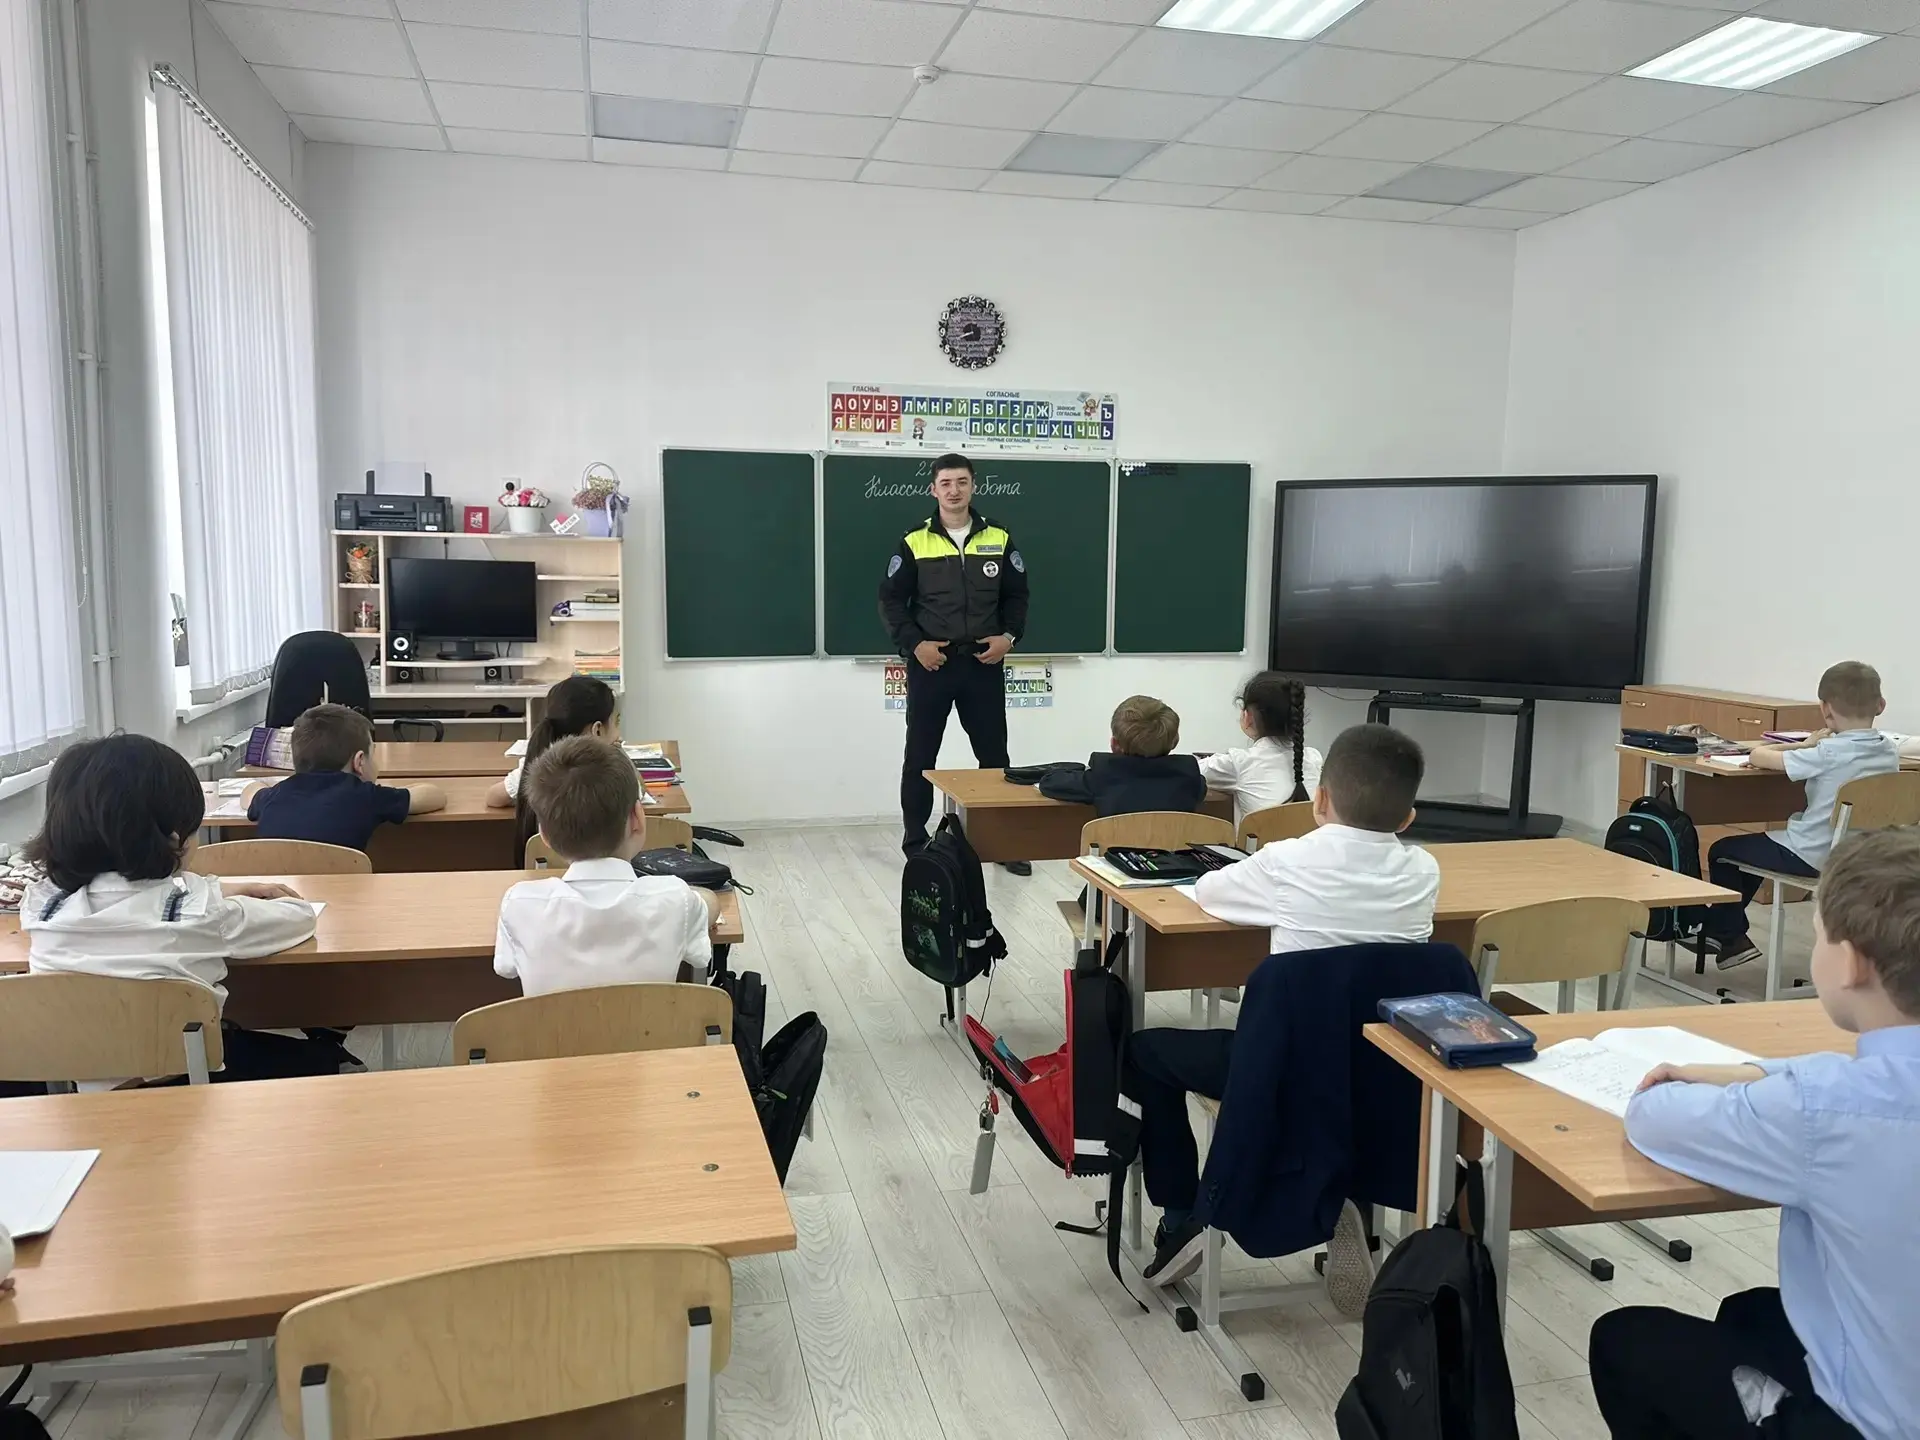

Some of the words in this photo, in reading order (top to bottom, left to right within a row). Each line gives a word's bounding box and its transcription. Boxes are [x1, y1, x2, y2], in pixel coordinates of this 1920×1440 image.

[834, 398, 843, 410] А
[848, 398, 857, 410] О
[862, 399, 870, 410] У
[875, 400, 886, 411] Ы
[890, 400, 898, 412] Э
[904, 400, 912, 412] Л
[917, 401, 926, 412] М
[931, 402, 940, 413] Н
[945, 402, 952, 414] Р
[958, 400, 967, 414] Й
[972, 403, 980, 414] Б
[986, 404, 994, 415] В
[1000, 404, 1007, 415] Г
[1024, 405, 1034, 418] Д
[1037, 405, 1049, 417] Ж
[1102, 408, 1112, 418] Ъ
[835, 417, 842, 428] Я
[861, 418, 872, 429] Ю
[876, 418, 884, 430] И
[891, 419, 898, 430] Е
[972, 422, 980, 432] П
[984, 422, 994, 433] Ф
[998, 423, 1006, 434] К
[1012, 423, 1019, 434] С
[1026, 424, 1032, 434] Т
[1037, 424, 1048, 435] Ш
[1052, 424, 1060, 436] Х
[1064, 425, 1072, 438] Ц
[1077, 425, 1085, 436] Ч
[1088, 426, 1100, 438] Щ
[1103, 426, 1110, 437] Ь
